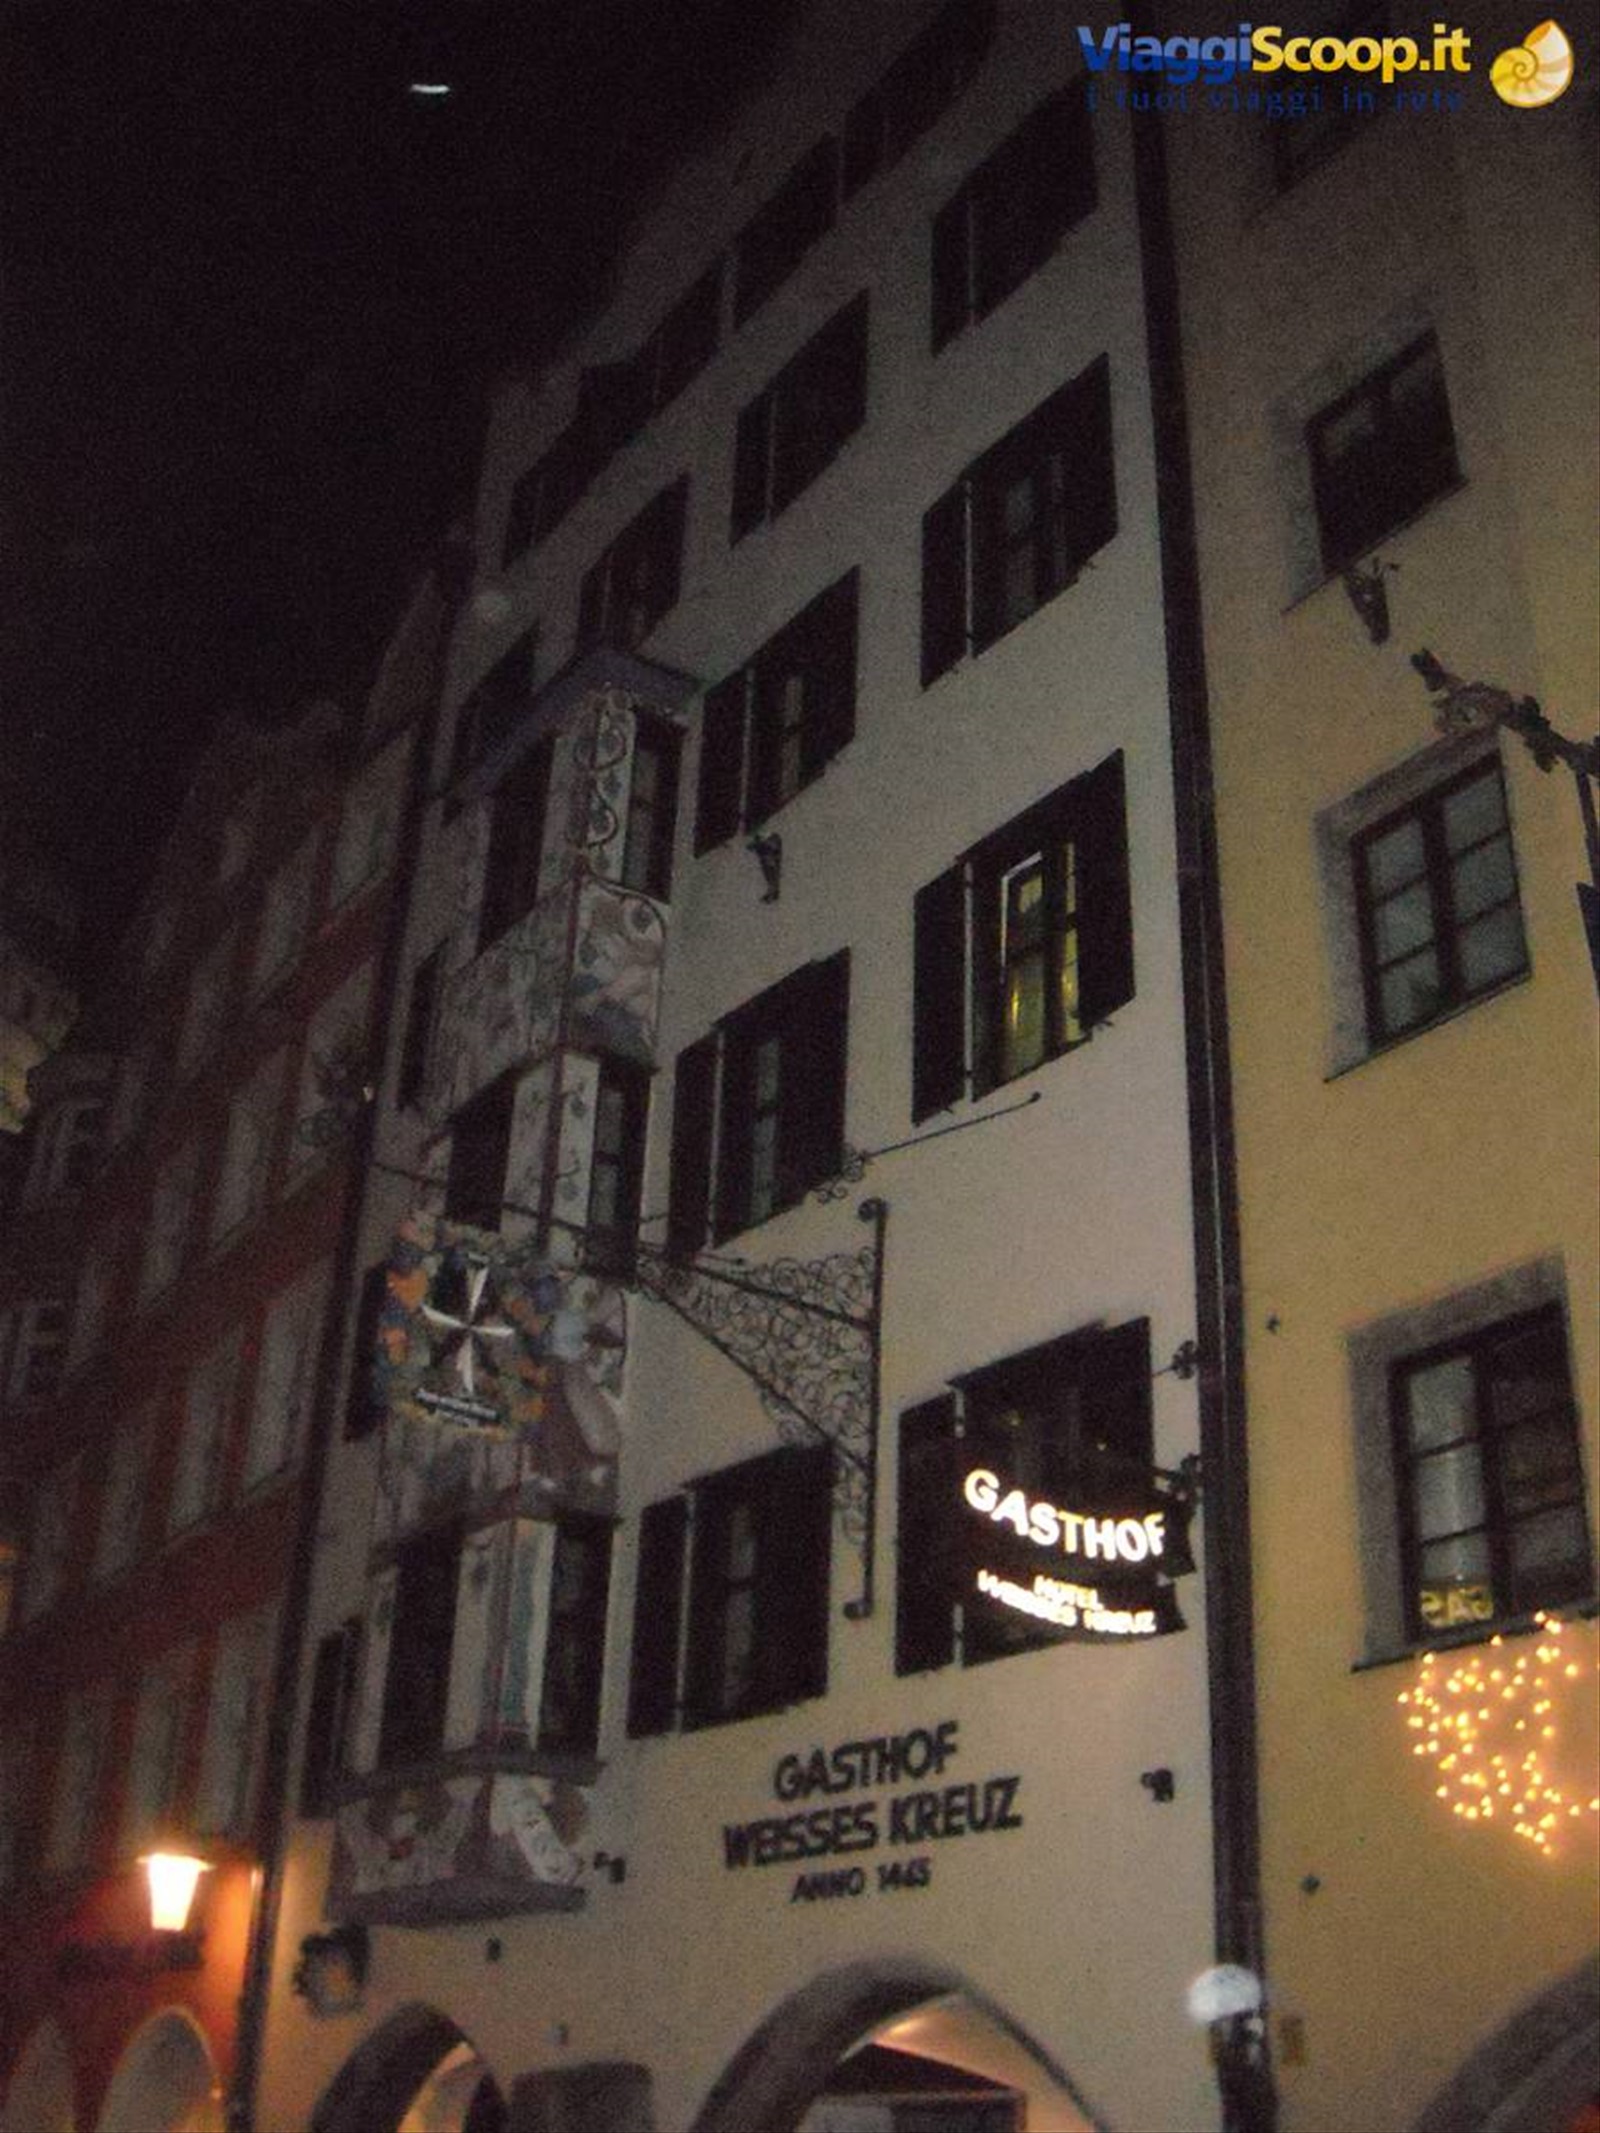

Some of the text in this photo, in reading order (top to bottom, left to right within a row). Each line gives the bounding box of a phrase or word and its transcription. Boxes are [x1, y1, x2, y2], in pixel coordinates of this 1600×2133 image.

[964, 1468, 1166, 1562] GASTHOF
[773, 1719, 959, 1803] GASTHOF
[722, 1775, 1023, 1870] WEISSES KREUZ
[791, 1866, 866, 1902] ANNO
